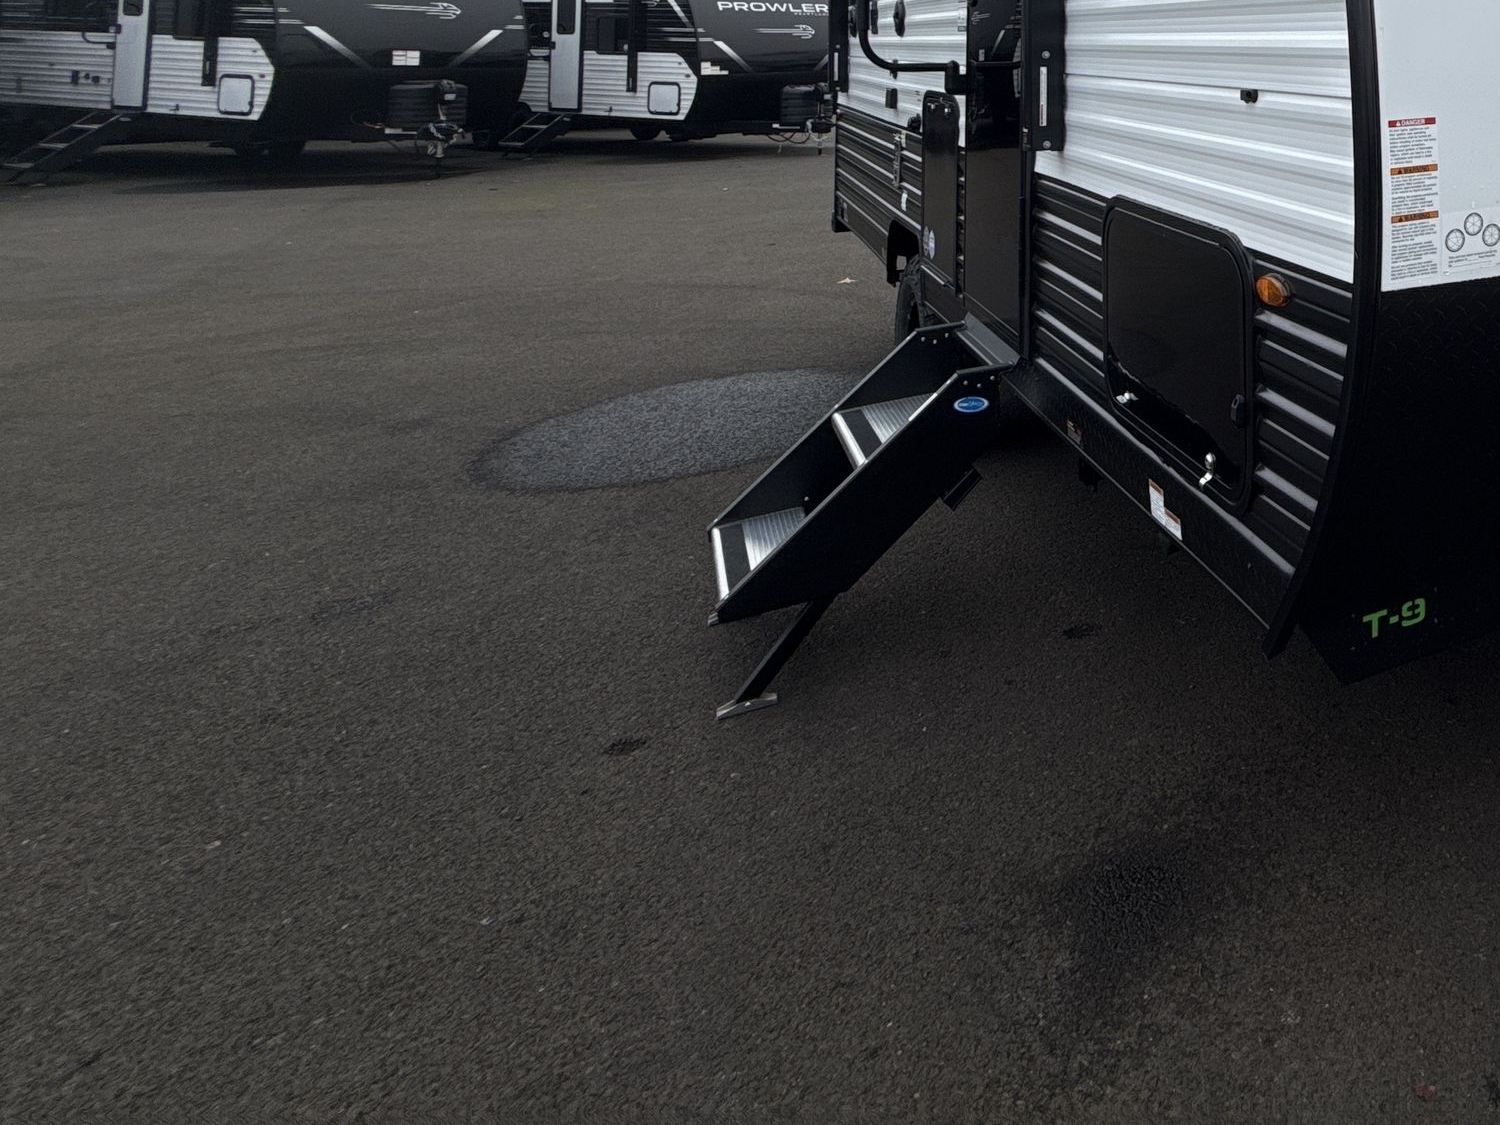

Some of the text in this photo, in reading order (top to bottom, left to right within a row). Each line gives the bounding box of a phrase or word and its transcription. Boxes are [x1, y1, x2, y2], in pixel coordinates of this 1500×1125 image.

[717, 1, 829, 13] PROWLER
[1401, 118, 1426, 127] DANGER
[1362, 597, 1426, 639] T-9
